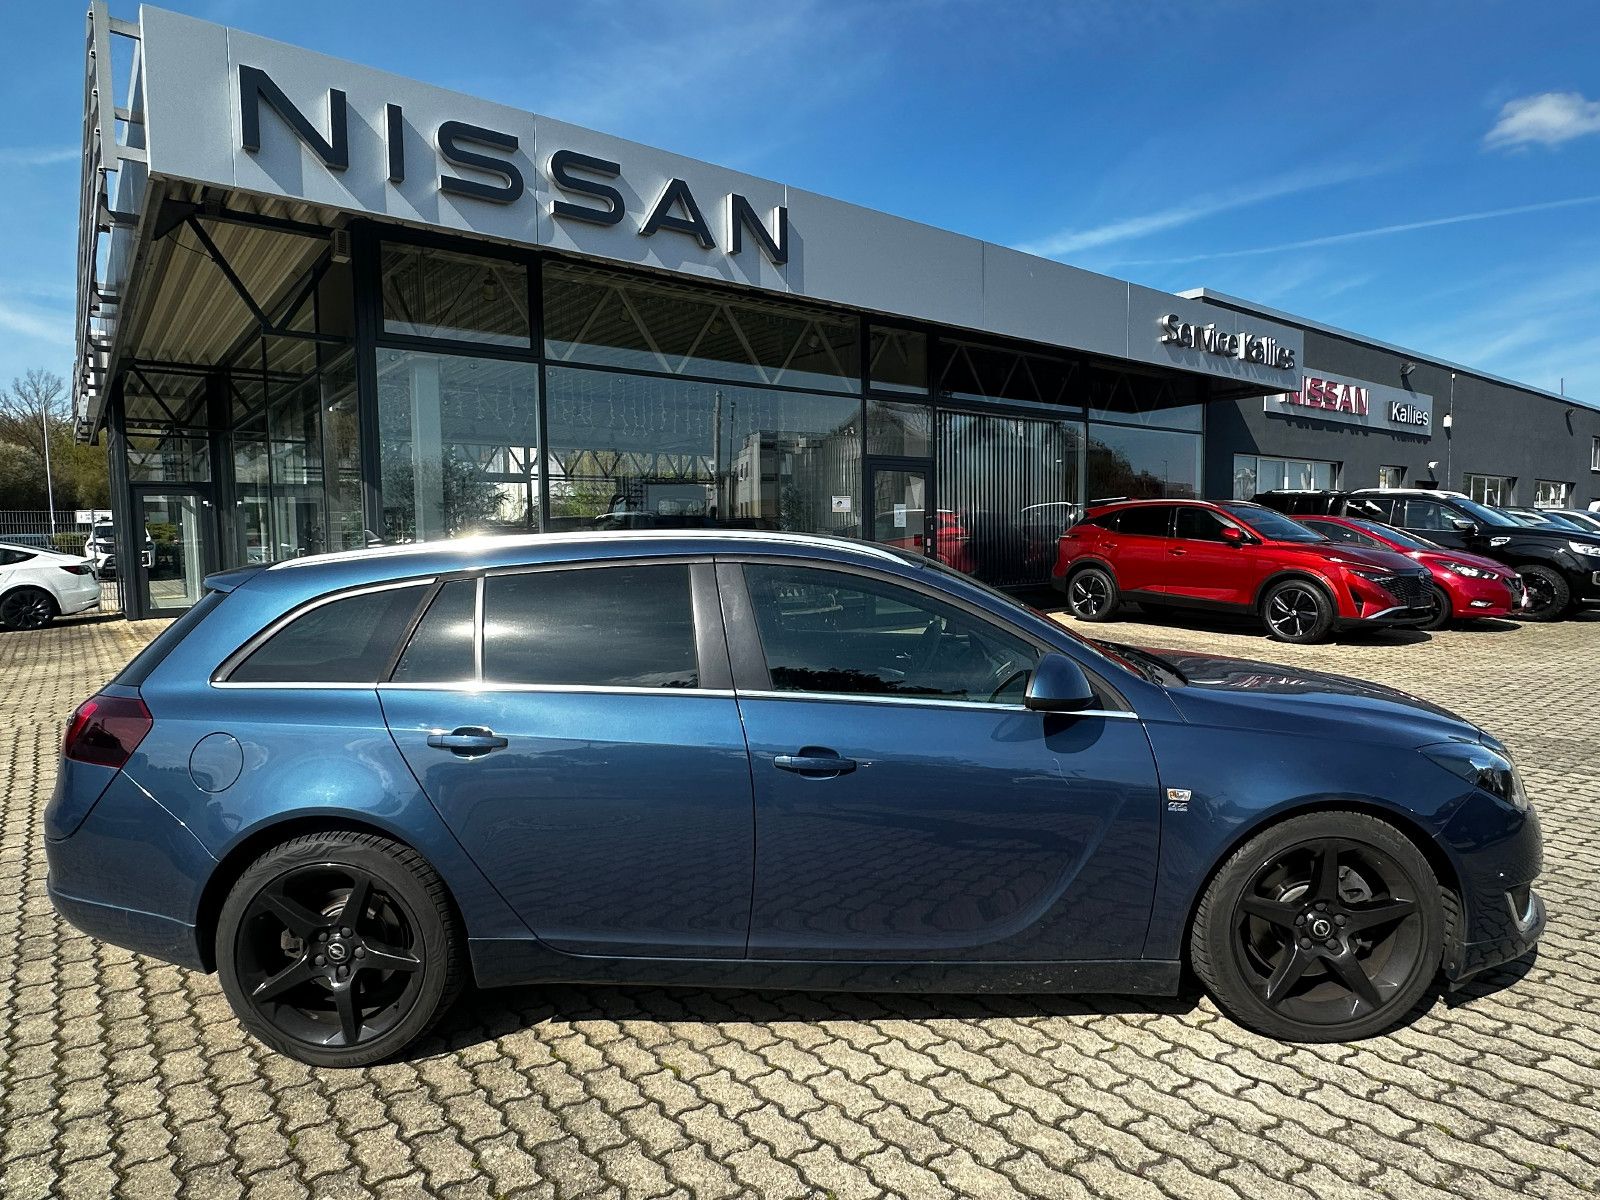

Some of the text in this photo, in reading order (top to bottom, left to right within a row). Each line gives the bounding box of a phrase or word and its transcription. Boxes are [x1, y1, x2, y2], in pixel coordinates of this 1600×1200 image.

[238, 64, 788, 264] NISSAN
[1161, 313, 1295, 369] Service Kallies
[1391, 401, 1429, 426] Kallies
